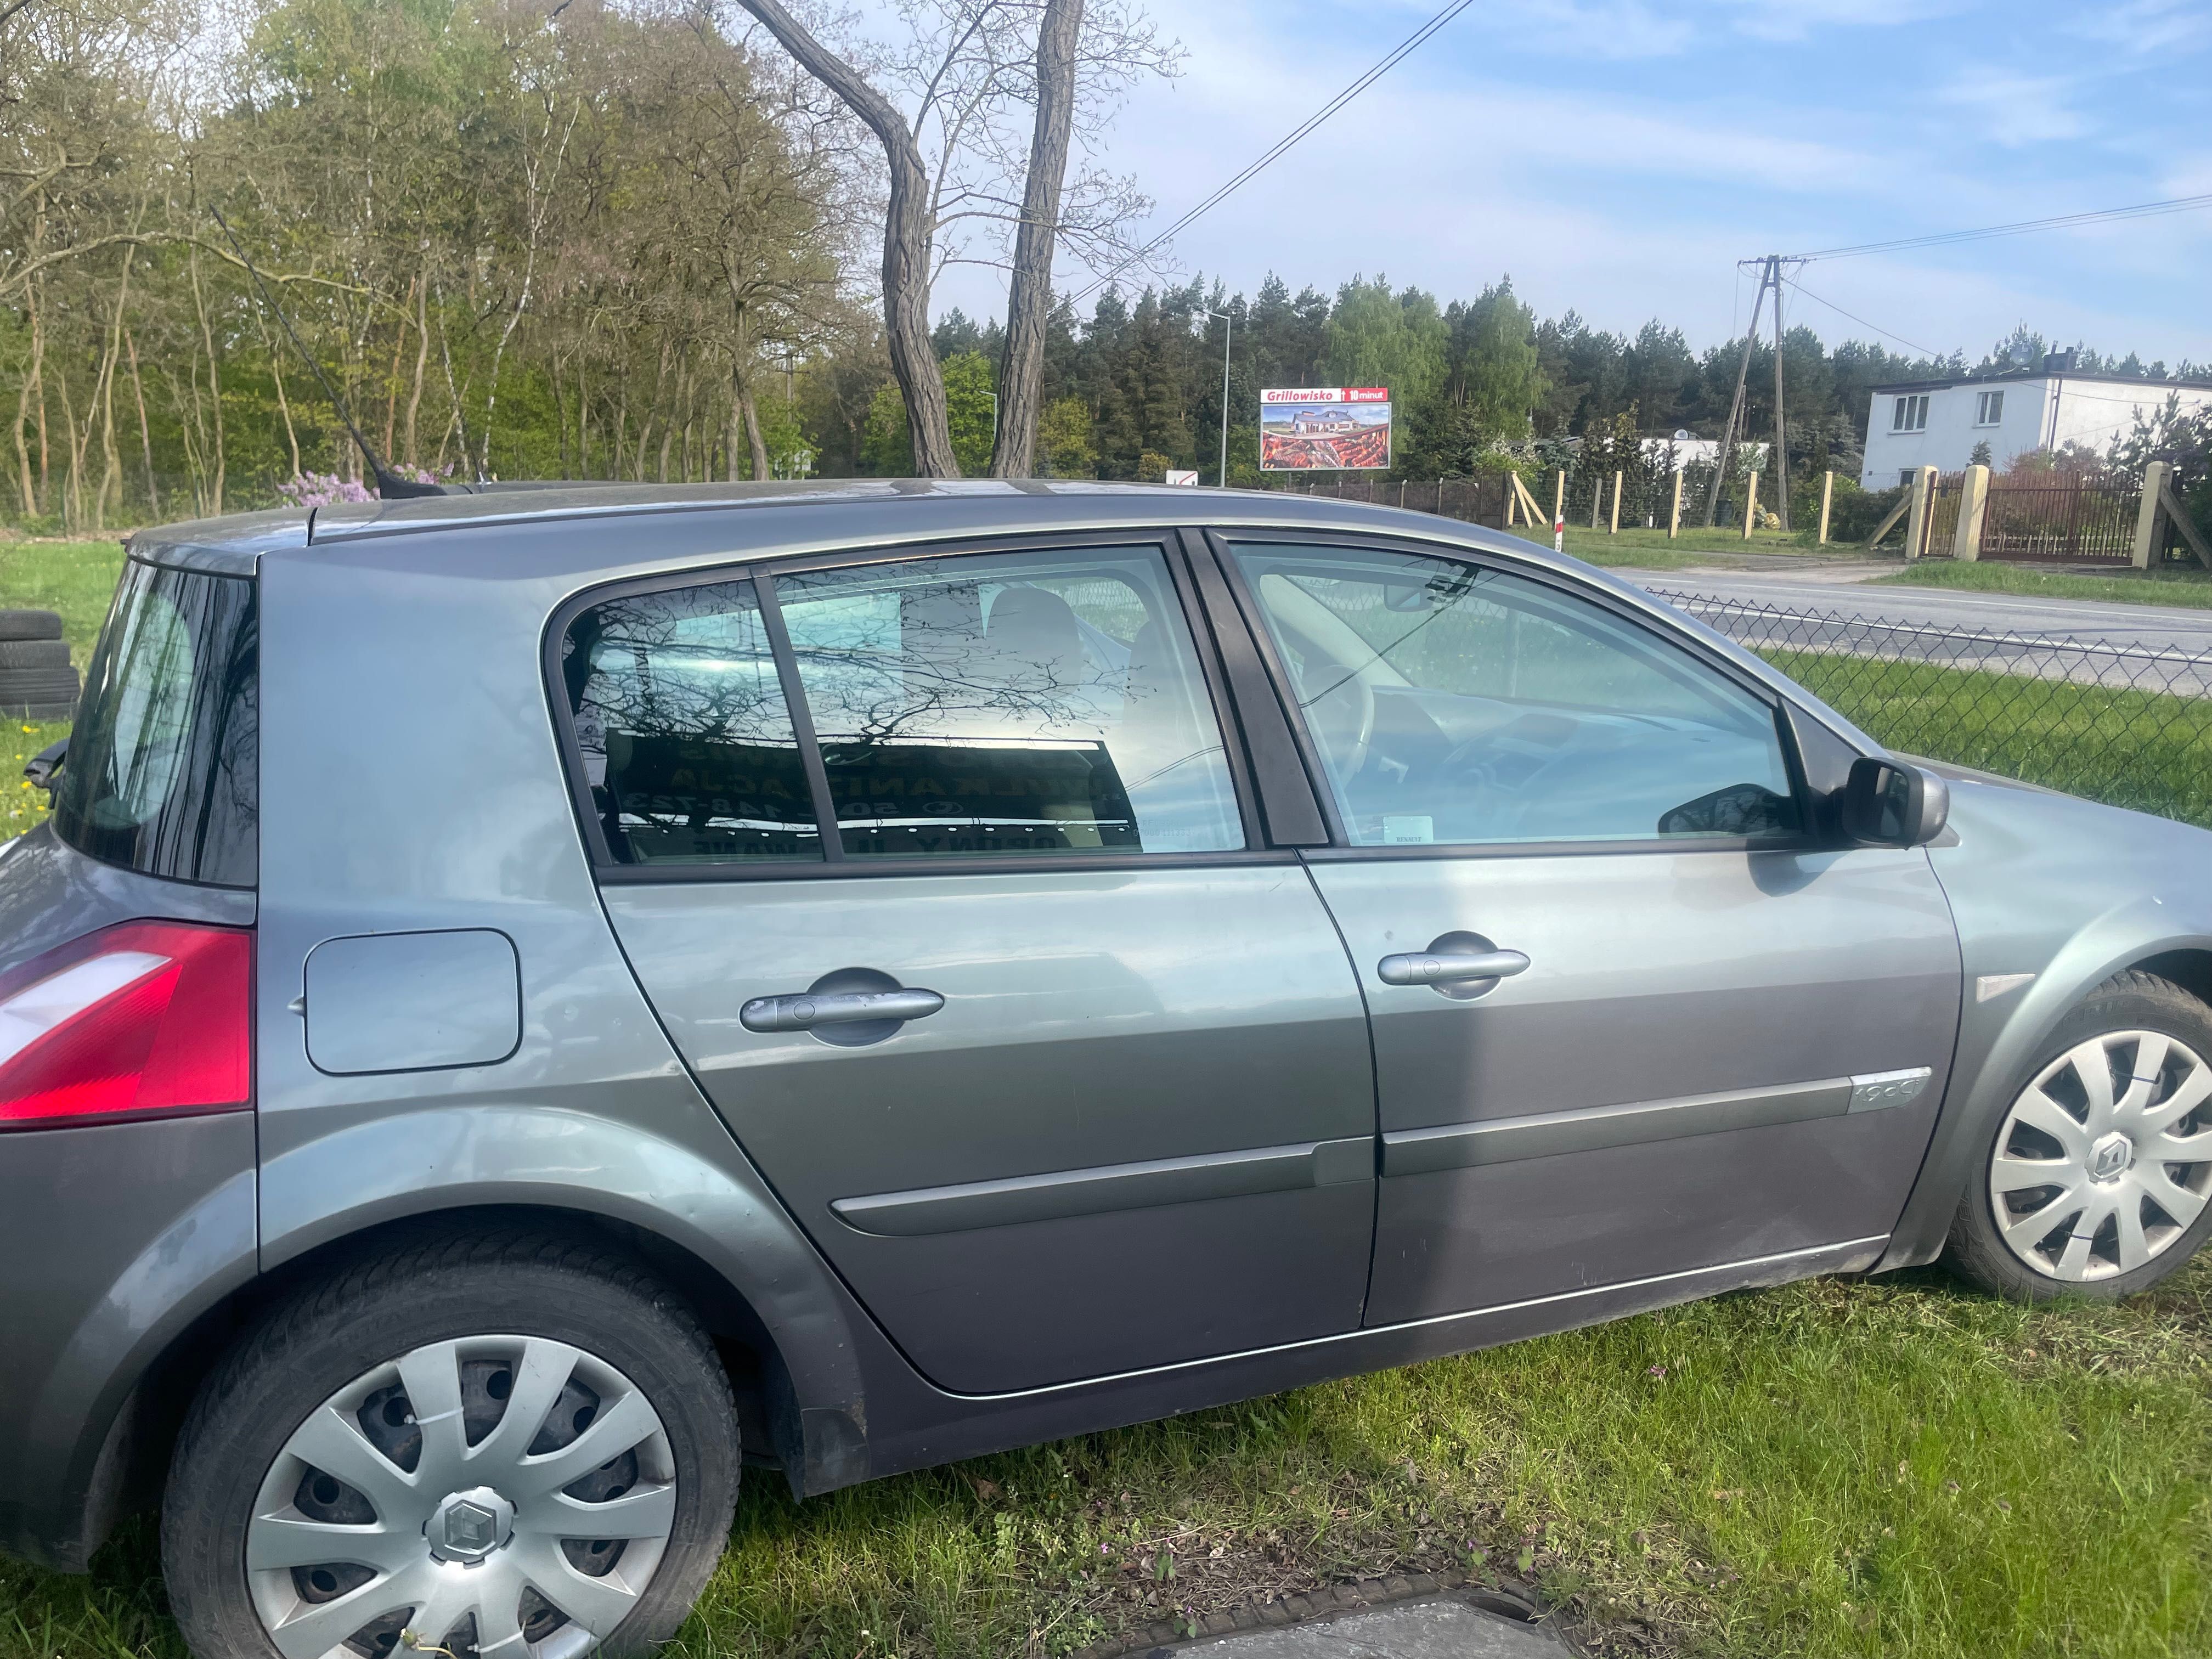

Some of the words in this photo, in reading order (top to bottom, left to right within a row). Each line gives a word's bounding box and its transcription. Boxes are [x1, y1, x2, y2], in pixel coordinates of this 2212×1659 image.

[1268, 391, 1333, 400] Grillowisko
[1350, 390, 1359, 400] 10
[1359, 391, 1384, 399] minut
